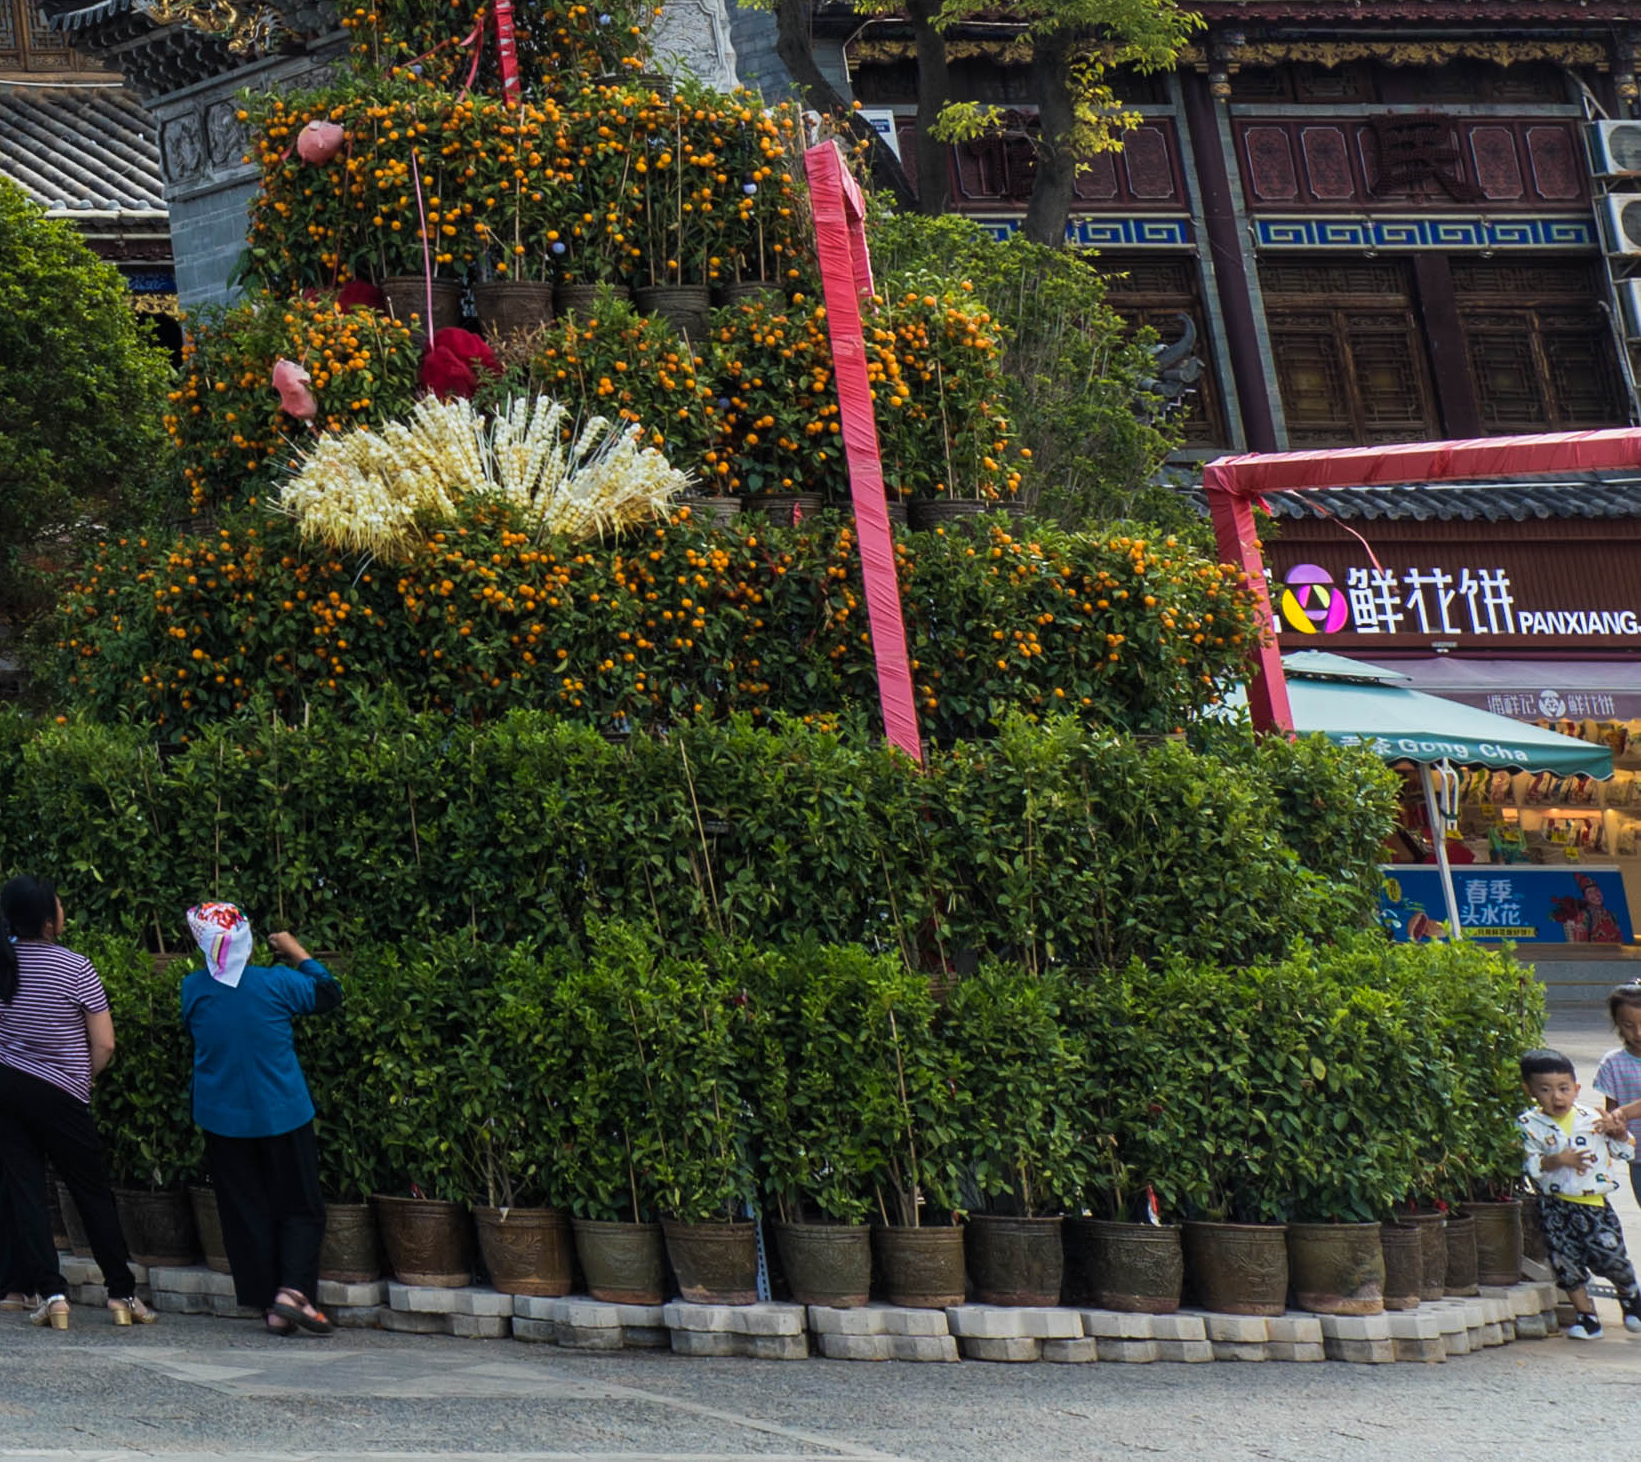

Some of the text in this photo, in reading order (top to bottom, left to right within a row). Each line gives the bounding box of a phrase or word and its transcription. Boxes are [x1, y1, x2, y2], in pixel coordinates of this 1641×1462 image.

[1347, 567, 1515, 635] 鲜花饼
[1518, 610, 1641, 635] PANXIANG
[1567, 693, 1616, 716] 鲜花饼
[1397, 736, 1529, 763] Gong Cha
[1465, 879, 1513, 905] 春季
[1460, 904, 1521, 926] 头水花
